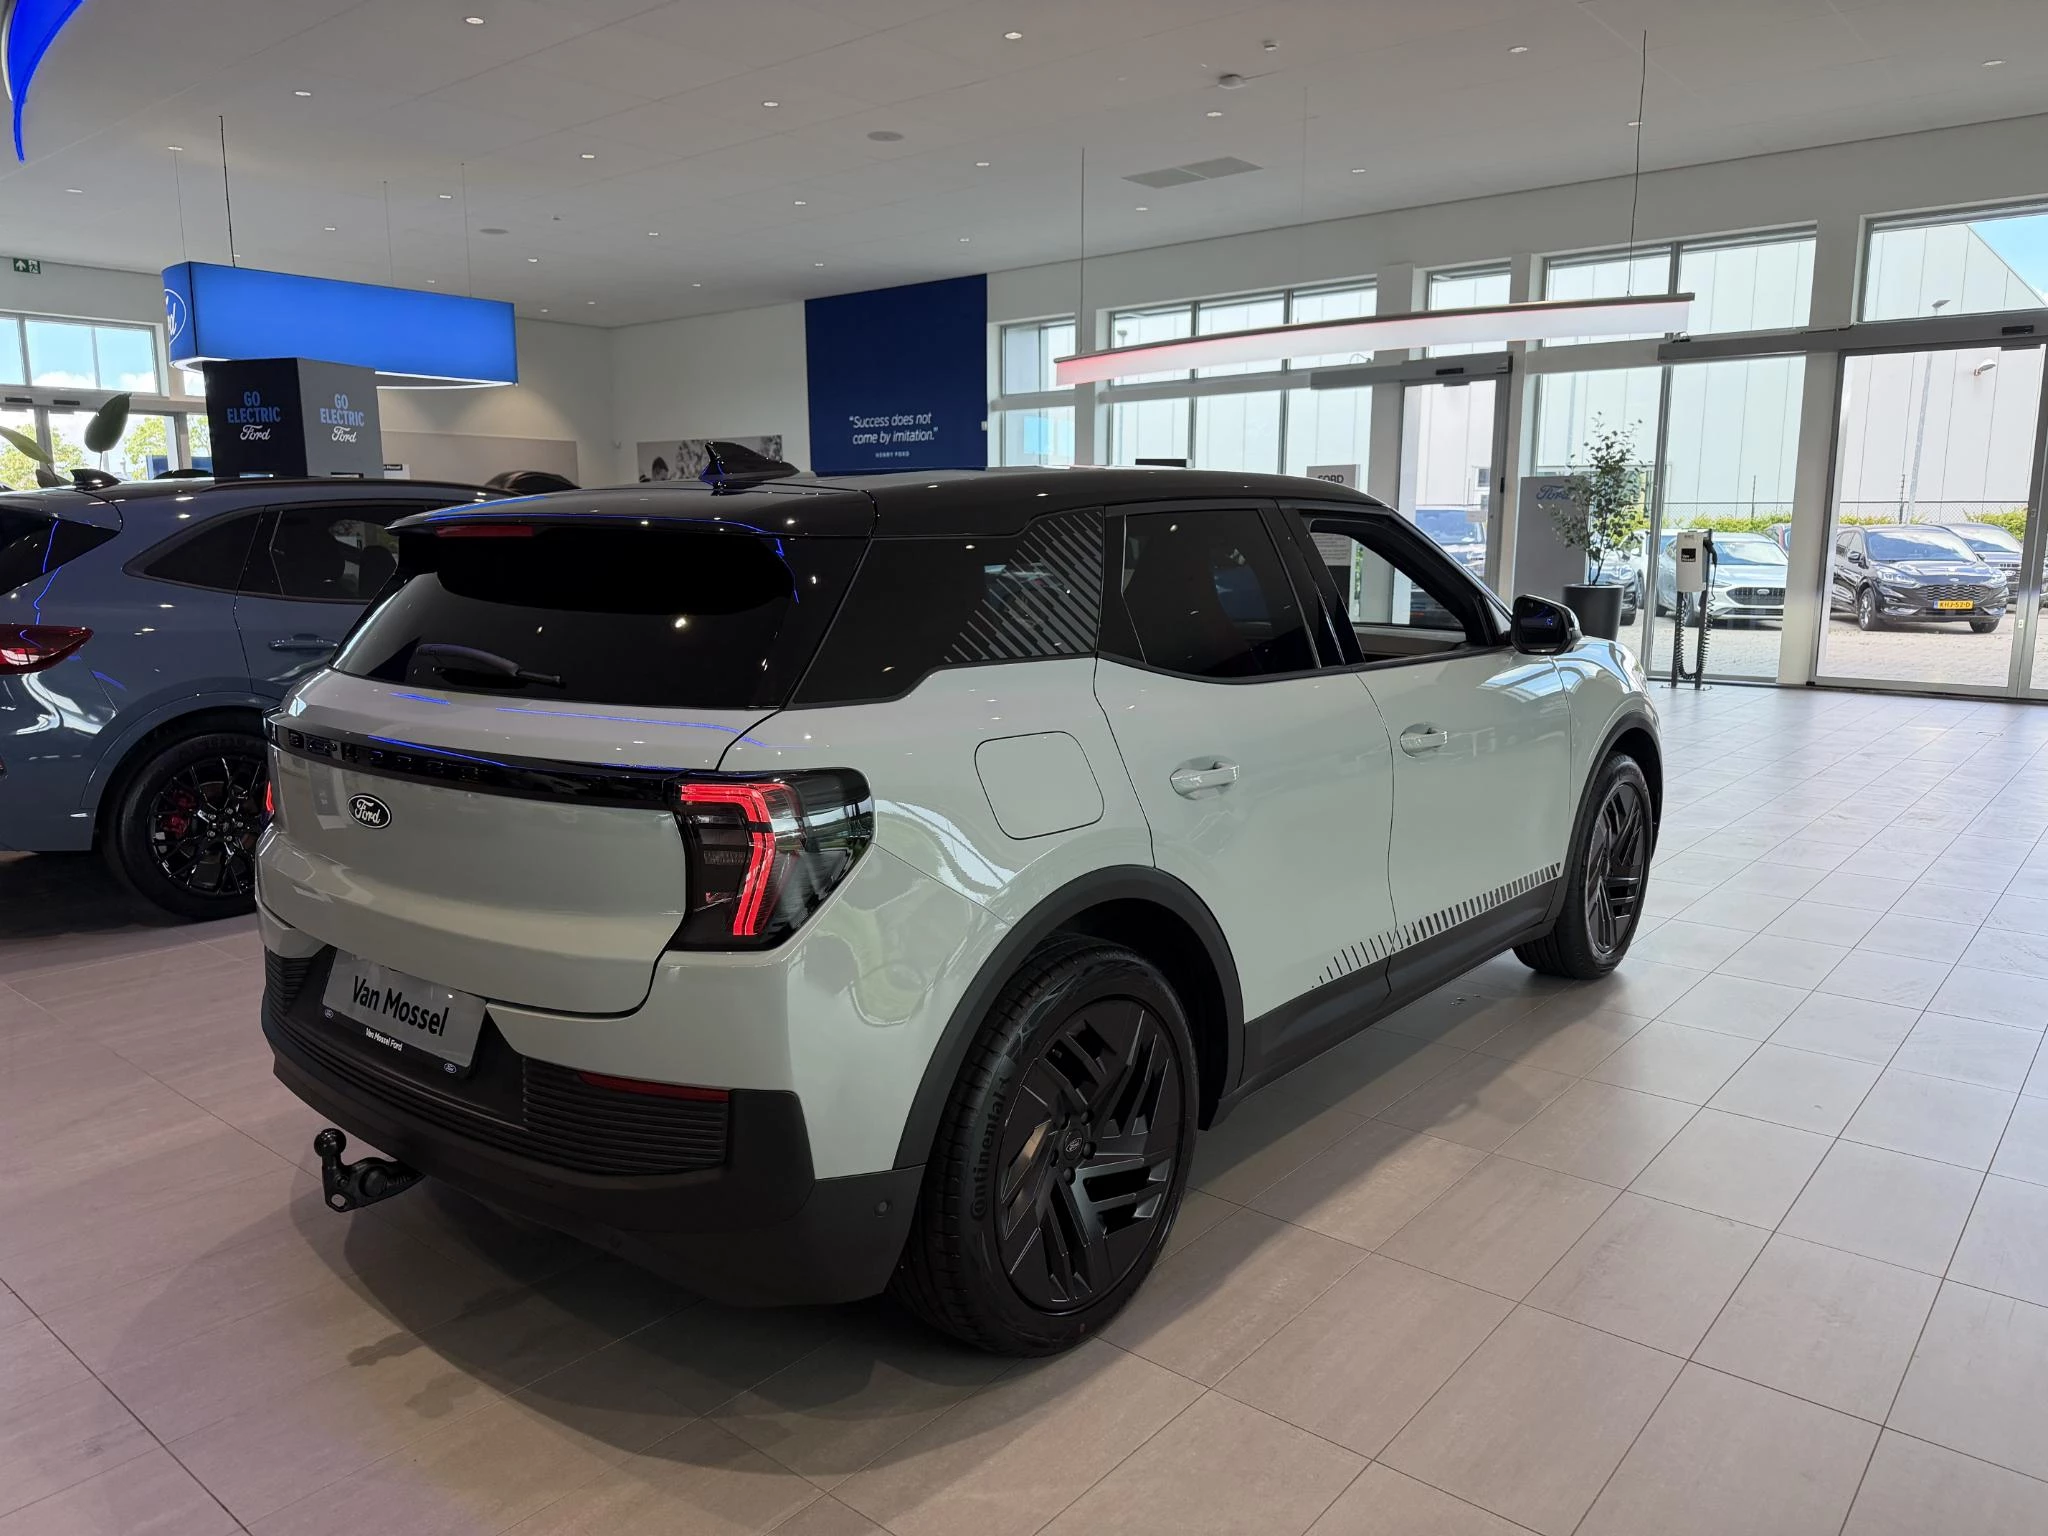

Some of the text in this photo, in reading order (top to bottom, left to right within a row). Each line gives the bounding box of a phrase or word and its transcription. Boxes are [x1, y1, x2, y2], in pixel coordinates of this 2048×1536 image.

[243, 391, 261, 407] GO
[334, 393, 349, 409] GO
[227, 407, 281, 424] ELECTRIC
[319, 407, 365, 427] ELECTRIC
[891, 413, 914, 426] does
[915, 411, 932, 425] not
[240, 424, 271, 441] Ford
[331, 425, 357, 443] Ford
[852, 433, 878, 445] come
[879, 430, 892, 445] by
[354, 798, 381, 824] Ford
[352, 975, 450, 1037] Van Mossel
[365, 1027, 403, 1052] Van Mossel Ford
[972, 1091, 1006, 1218] Continental
